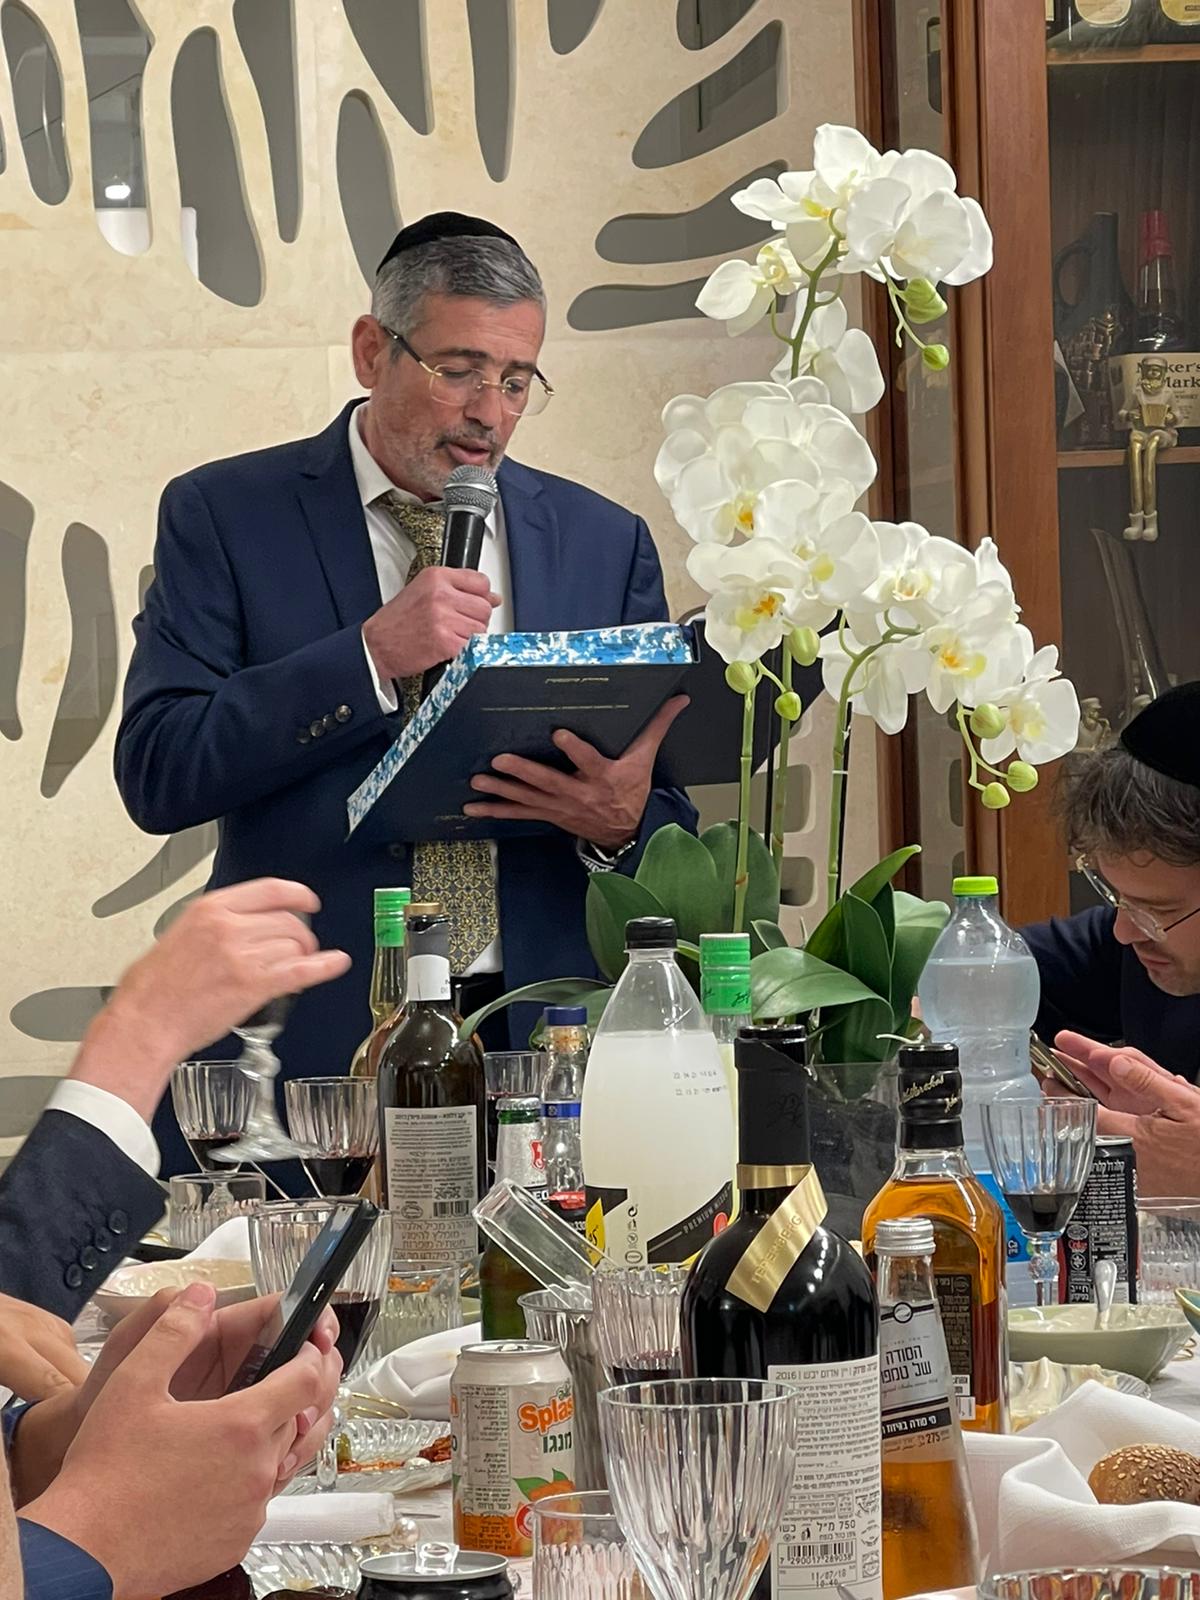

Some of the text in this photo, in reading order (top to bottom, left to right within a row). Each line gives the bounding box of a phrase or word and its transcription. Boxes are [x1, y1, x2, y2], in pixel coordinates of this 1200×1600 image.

[1136, 362, 1200, 373] ker's
[1164, 377, 1200, 388] ark
[886, 1345, 923, 1365] הסודה
[881, 1365, 909, 1385] טמפו
[912, 1361, 932, 1377] של
[776, 1372, 797, 1380] 2016
[542, 1432, 572, 1453] מנגו
[926, 1432, 940, 1444] 275
[839, 1520, 856, 1530] 750
